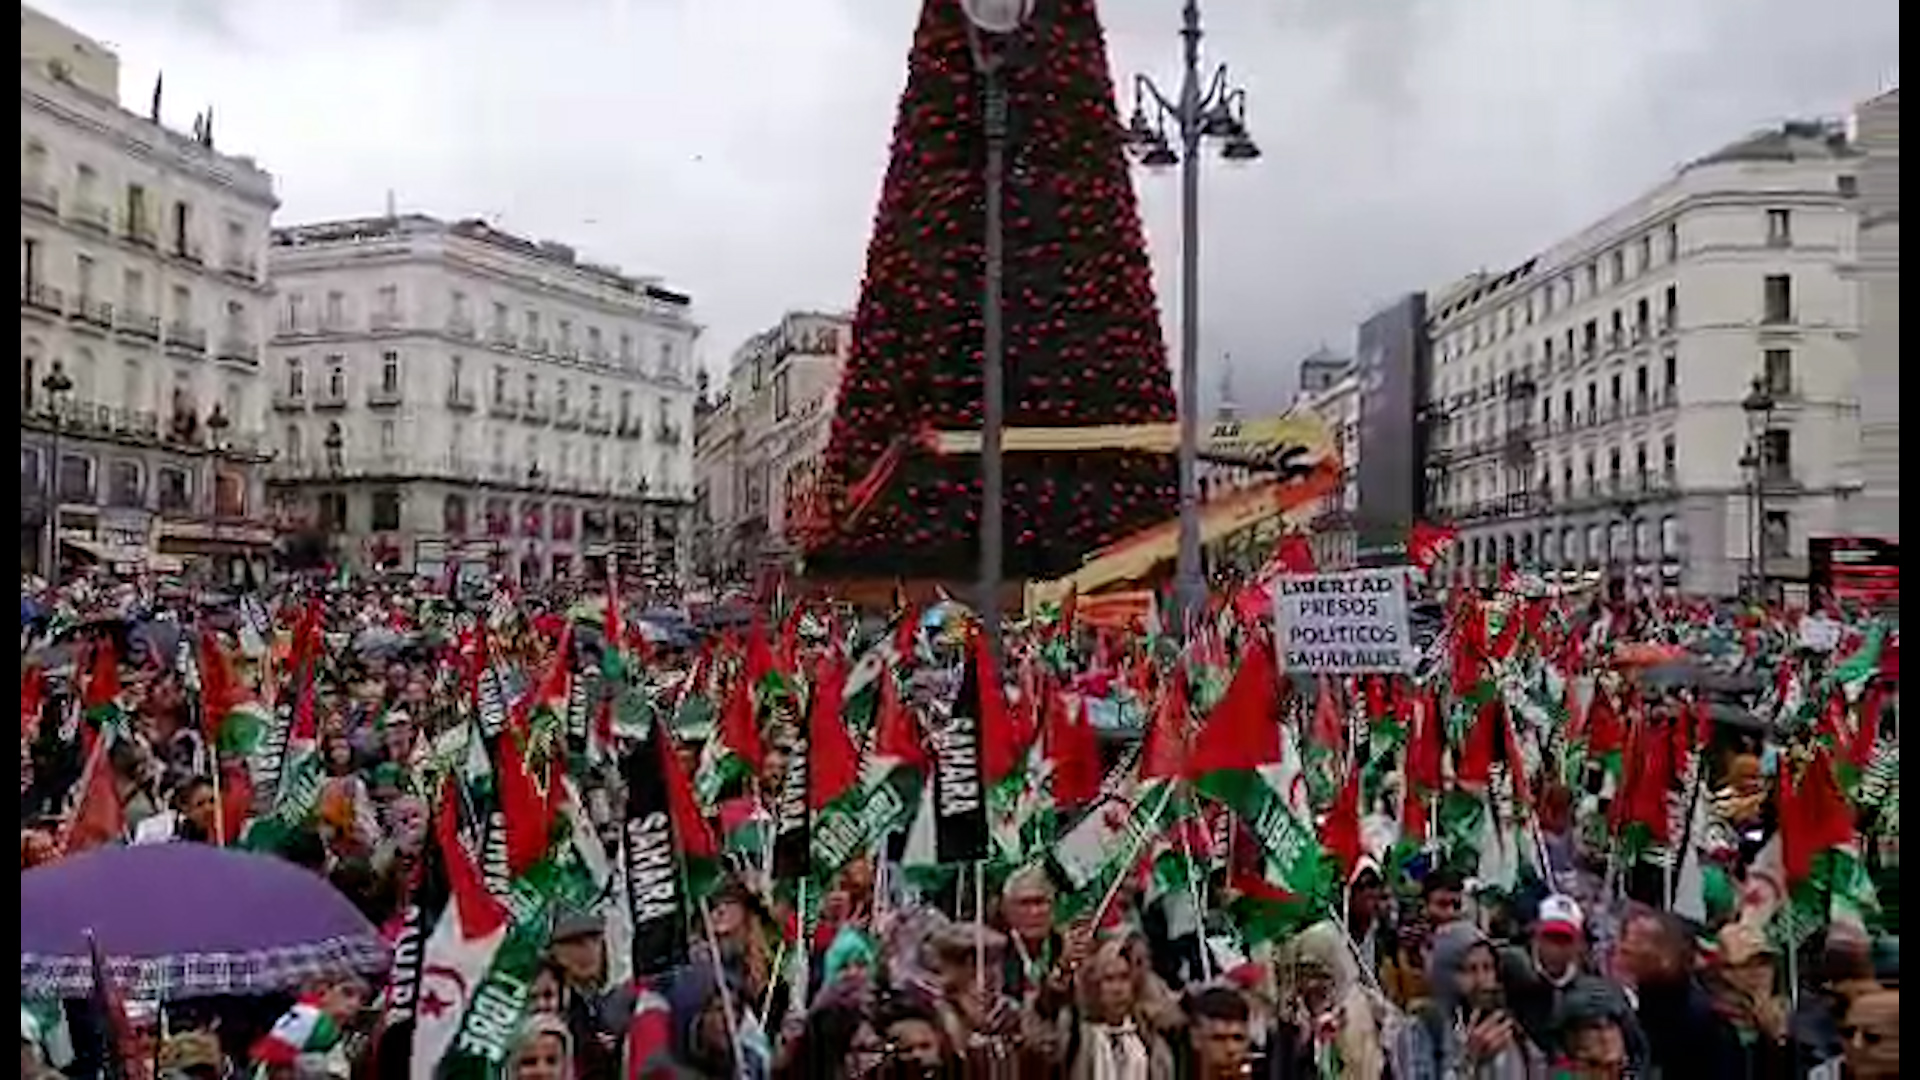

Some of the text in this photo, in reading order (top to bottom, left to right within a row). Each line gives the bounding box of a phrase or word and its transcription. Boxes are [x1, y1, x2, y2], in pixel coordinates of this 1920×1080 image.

[1282, 577, 1392, 596] LIBERTAD
[1300, 598, 1378, 617] PRESOS
[1290, 624, 1398, 644] POLITICOS
[939, 717, 980, 817] SAHARA
[626, 811, 678, 923] SAHARA
